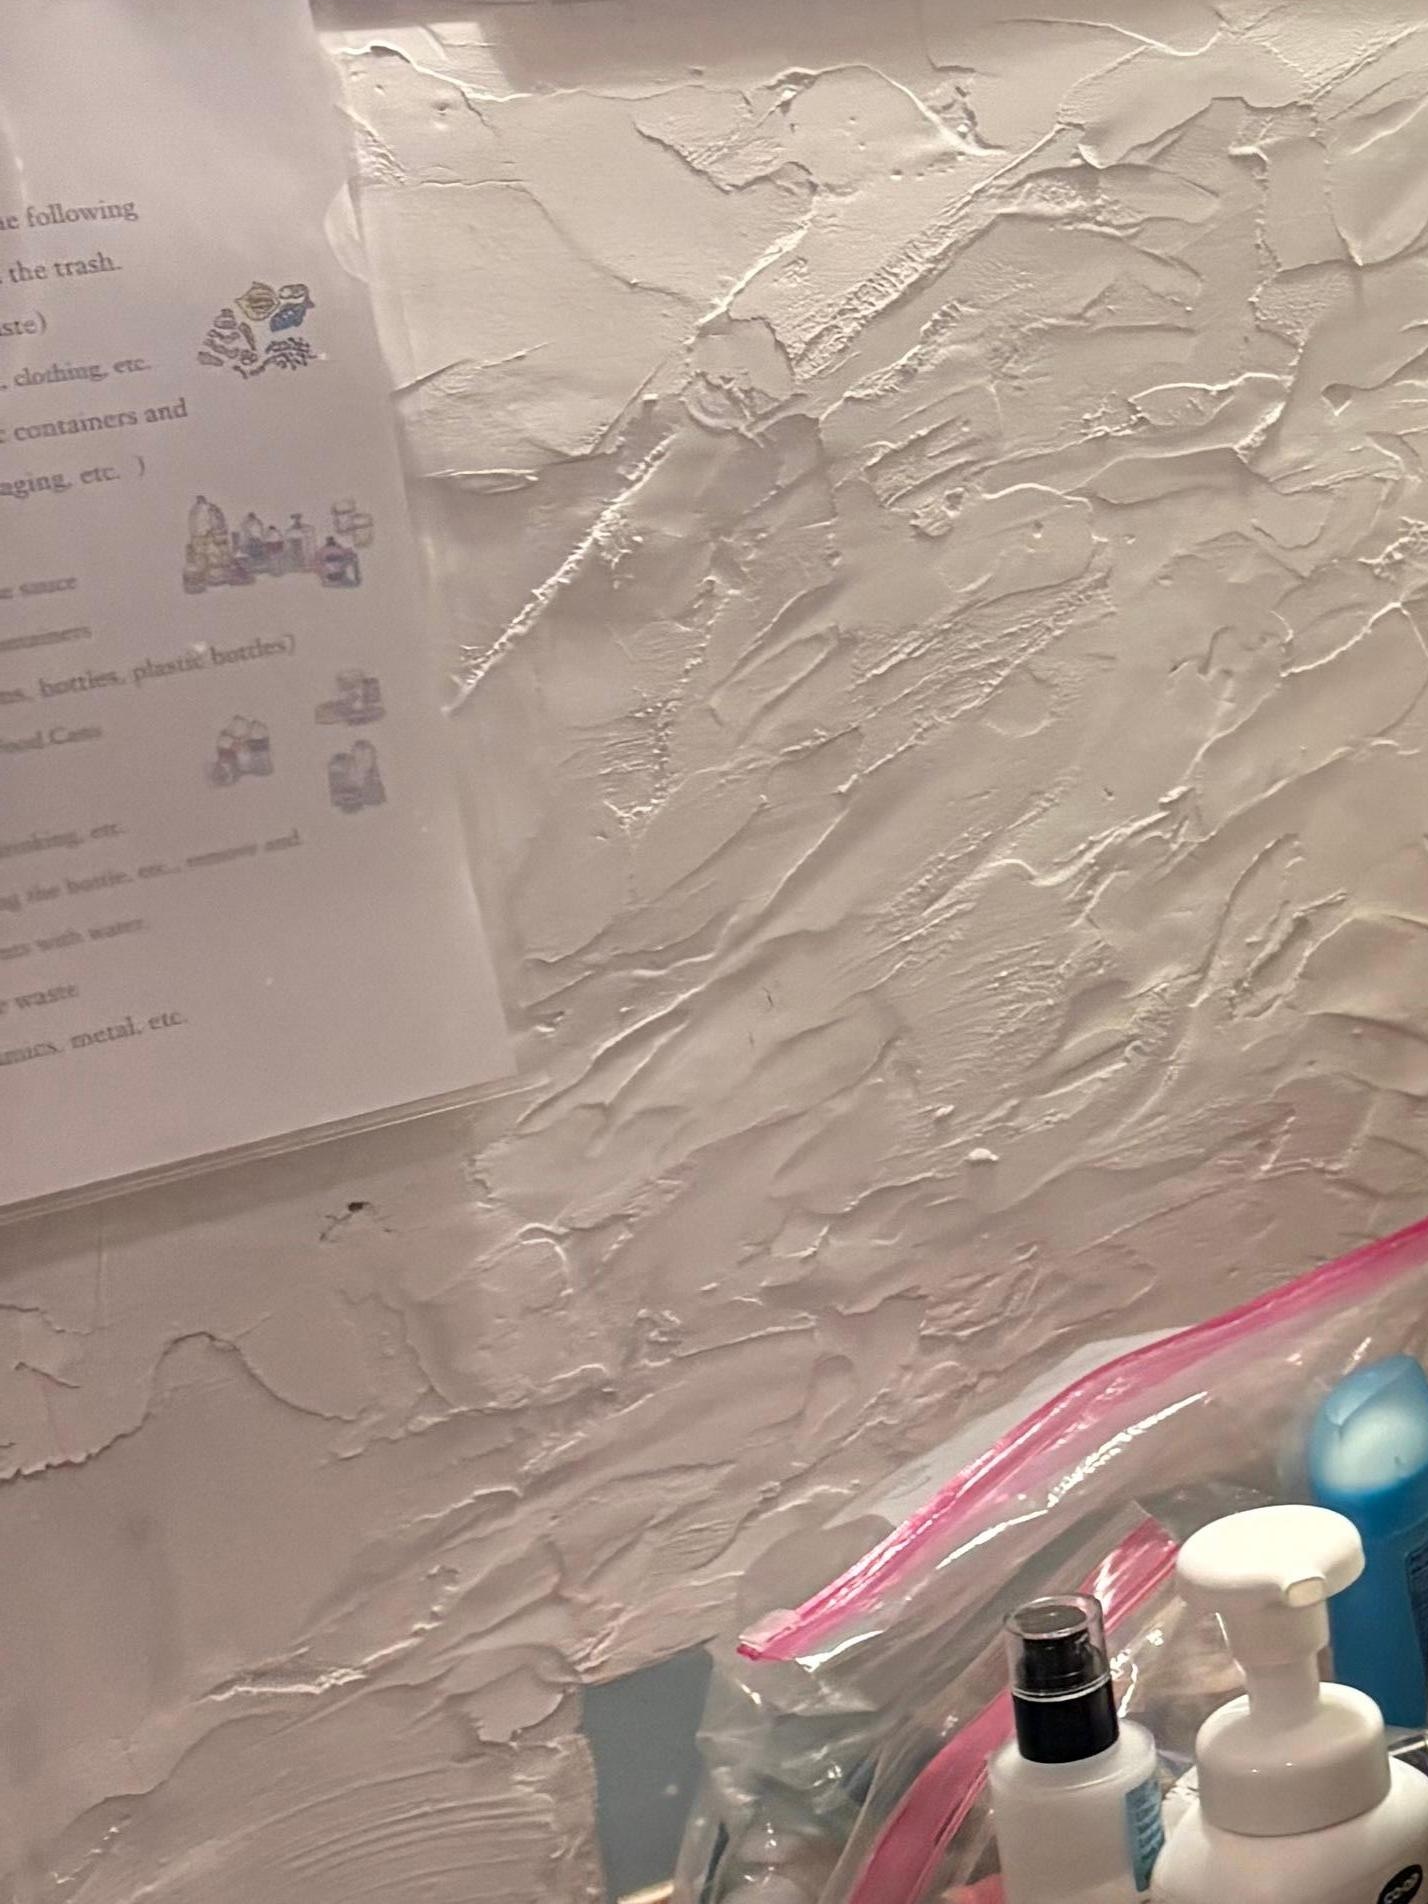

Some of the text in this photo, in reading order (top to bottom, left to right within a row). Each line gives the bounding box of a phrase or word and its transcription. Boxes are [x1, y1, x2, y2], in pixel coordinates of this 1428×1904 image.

[27, 200, 139, 227] following
[9, 251, 122, 284] the trash.
[14, 410, 138, 441] containers
[144, 396, 188, 423] and
[80, 467, 121, 485] etc.
